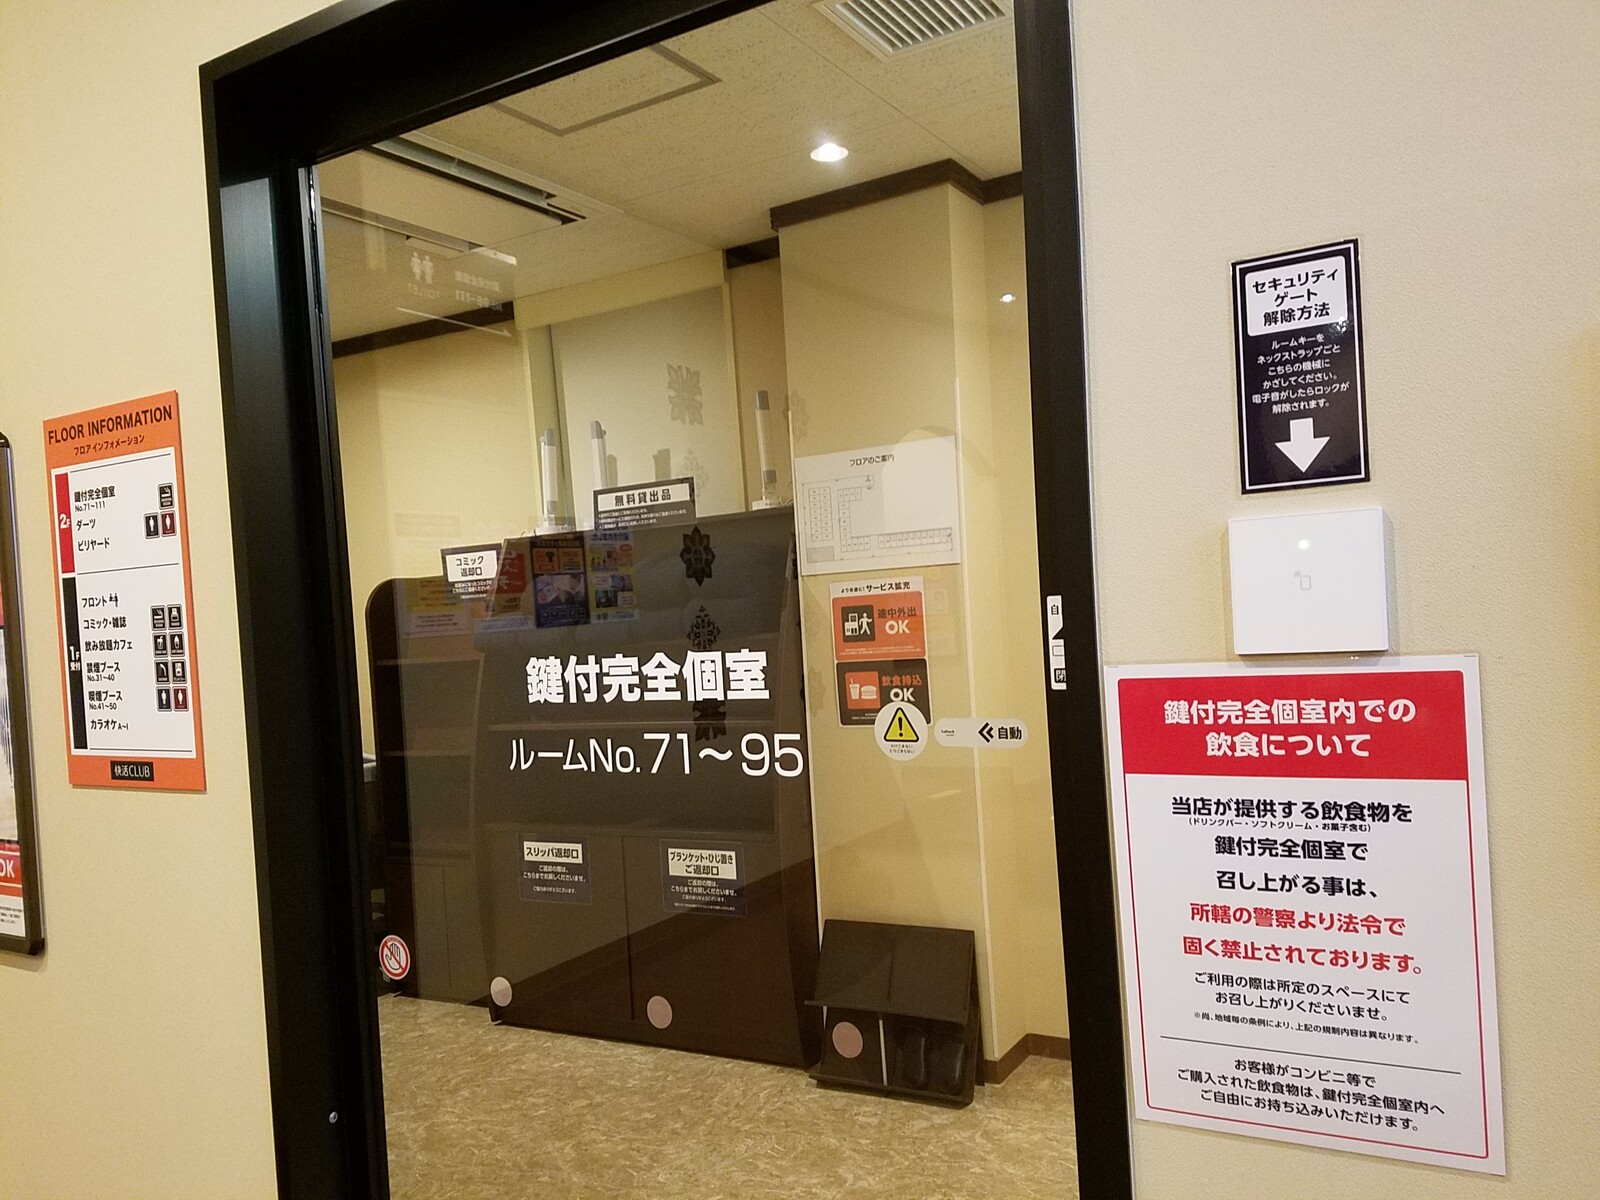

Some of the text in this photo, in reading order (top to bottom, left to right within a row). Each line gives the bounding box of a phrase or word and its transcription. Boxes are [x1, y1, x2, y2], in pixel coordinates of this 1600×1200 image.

[1252, 267, 1339, 295] セキュリティ
[1274, 288, 1318, 307] ゲート
[1263, 302, 1331, 327] 解除方法
[1271, 333, 1325, 350] ルームキーを
[1257, 343, 1341, 365] ネックストラップごと
[1268, 357, 1331, 376] こちらの機械に
[1262, 372, 1338, 390] かざしてください。
[1252, 381, 1351, 405] 電子音がしたらロックが
[1272, 398, 1330, 414] 解除されます。
[48, 404, 173, 445] FLOOR INFORMATION
[849, 454, 895, 467] フロアのご案内
[74, 485, 116, 503] 鍵付完全個室
[614, 488, 671, 507] 無料貸出品
[59, 513, 71, 529] 2F
[76, 518, 96, 531] ダーツ
[77, 537, 110, 552] ビリヤード
[456, 555, 484, 566] コミック
[460, 566, 483, 577] 返却口
[866, 581, 911, 592] サービス拡充
[81, 595, 108, 608] フロント
[878, 606, 917, 619] 途中外出
[83, 616, 127, 630] コミック・雑誌
[885, 619, 910, 635] OK
[69, 645, 80, 661] 1F
[85, 639, 133, 652] 飲み放題カフェ
[86, 662, 121, 673] 禁煙ブース
[525, 648, 770, 704] 鍵付完全個室
[881, 675, 922, 686] 飲食持込
[88, 690, 123, 702] 喫煙ブース
[889, 687, 916, 702] OK
[1164, 698, 1416, 726] 鍵付完全個室内での
[90, 719, 117, 730] カラオケ
[998, 726, 1022, 740] 自動
[1205, 731, 1372, 758] 飲食について
[114, 764, 151, 778] 快活CLUB
[1171, 796, 1413, 824] 当店が提供する飲食物を
[526, 847, 579, 859] スリッパ返却口
[1214, 836, 1369, 861] 鍵付完全個室で
[685, 864, 719, 876] ご返却口
[1216, 870, 1379, 898] 召し上がる事は、
[1190, 902, 1406, 936] 所轄の警察より法令で
[1182, 936, 1423, 975] 固く禁止されております。
[1194, 972, 1411, 1005] ご利用の際は所定のスペースにて
[1214, 992, 1389, 1022] お召し上がりくださいませ。
[1234, 1058, 1376, 1089] お客様がコンビニ等で
[1177, 1067, 1445, 1117] ご購入された飲食物は、鍵付完全個室内へ
[1200, 1088, 1420, 1132] ご自由にお持ち込みいただけます。
